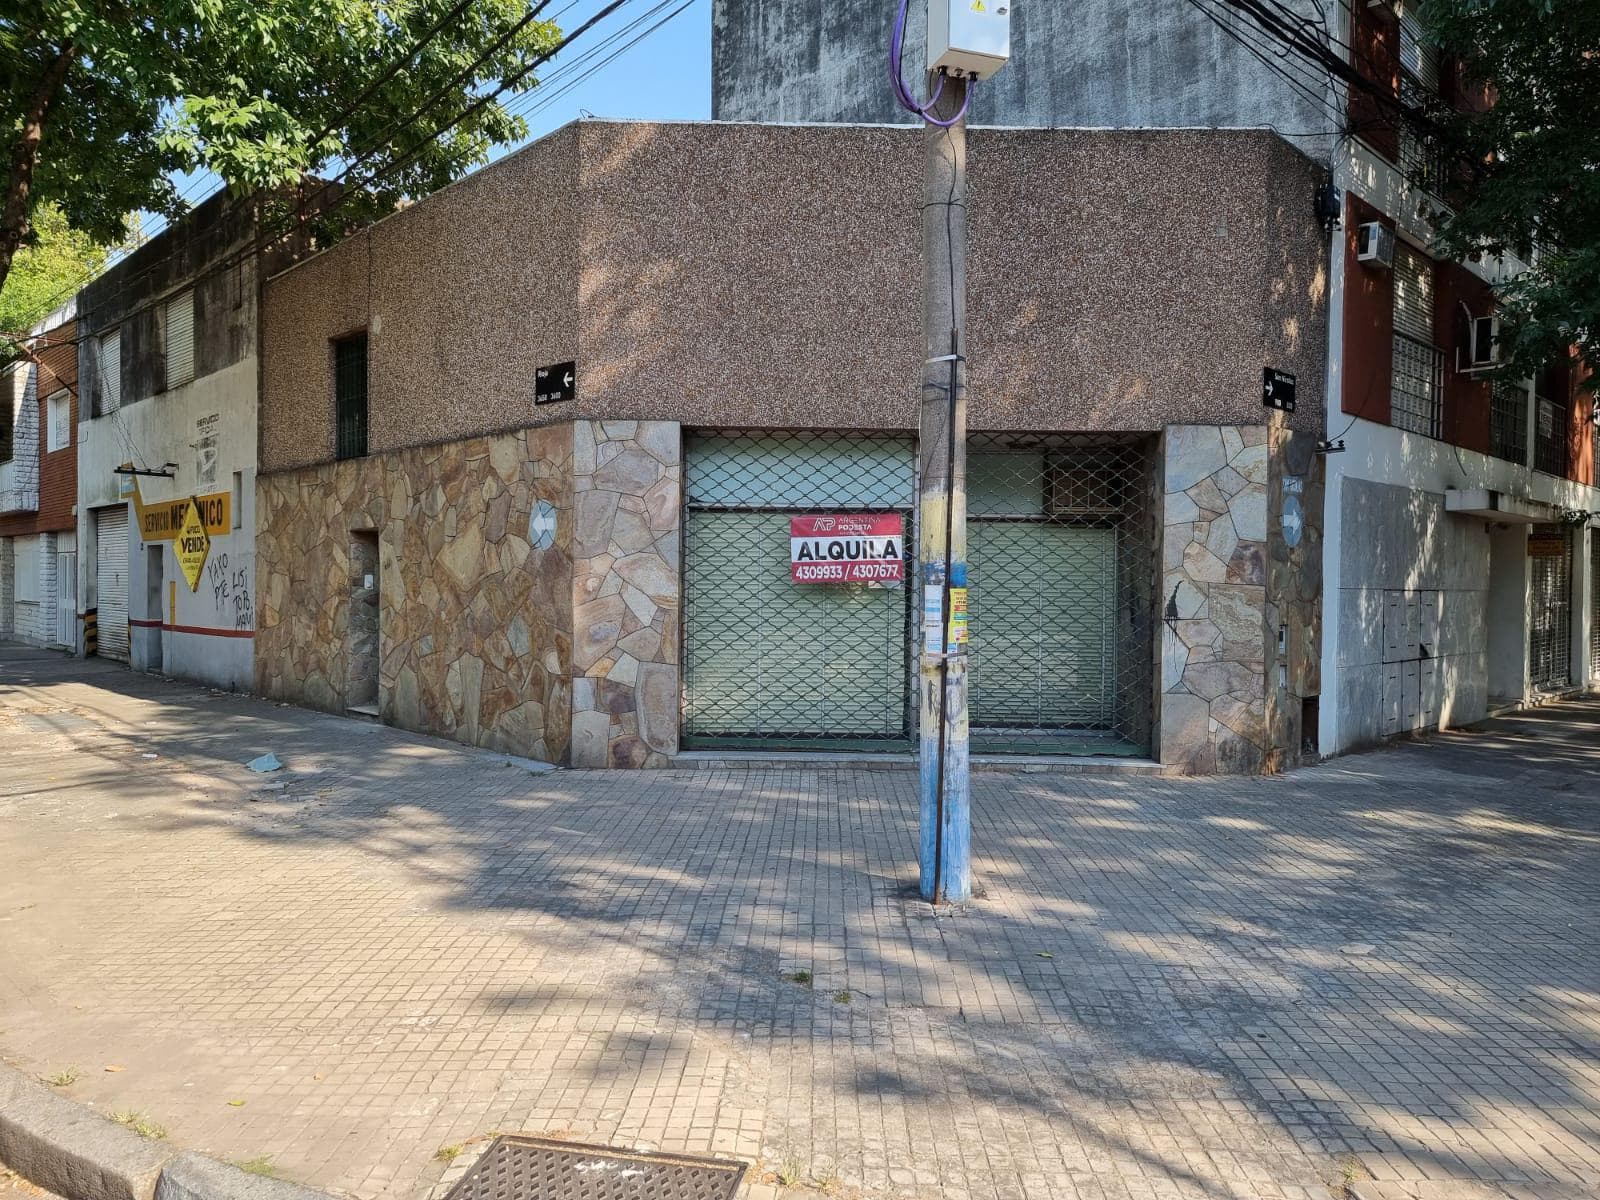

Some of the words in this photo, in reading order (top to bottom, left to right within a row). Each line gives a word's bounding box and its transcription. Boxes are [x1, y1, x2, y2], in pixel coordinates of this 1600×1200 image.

[144, 511, 169, 533] SERVICIO
[170, 498, 223, 531] MENICO
[180, 535, 205, 554] VENDE
[797, 539, 899, 561] ALQUILA
[796, 565, 843, 579] 4309933
[852, 564, 899, 578] 4307677
